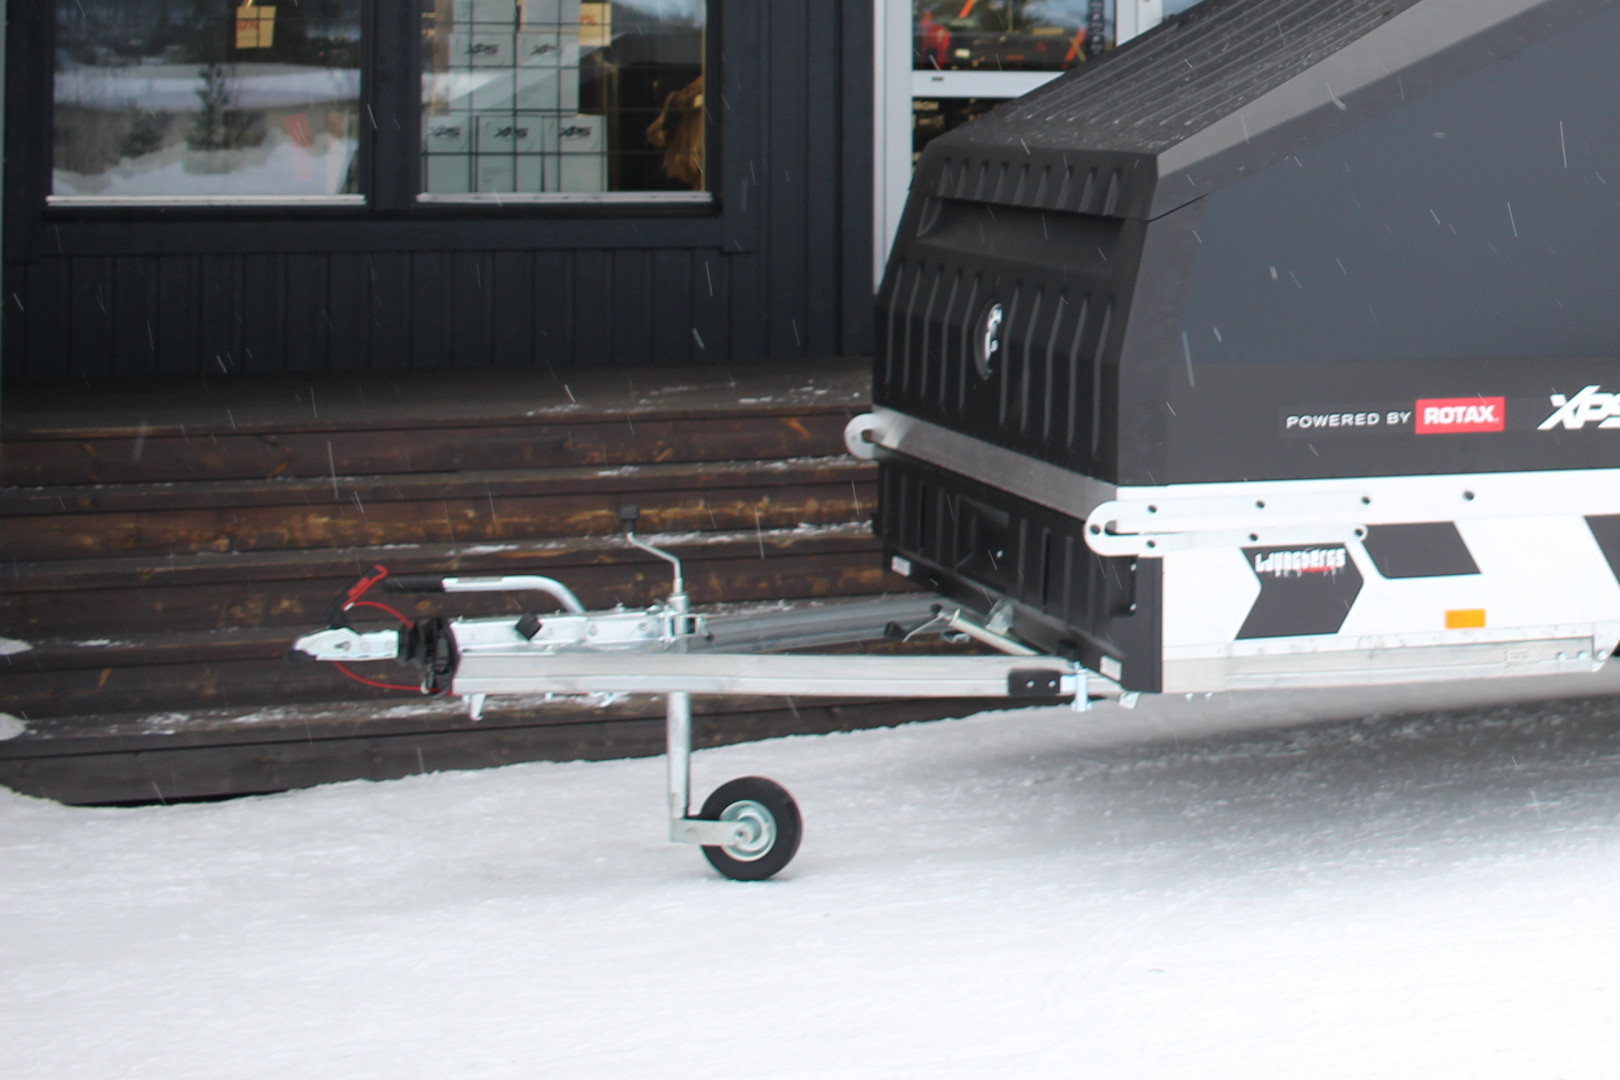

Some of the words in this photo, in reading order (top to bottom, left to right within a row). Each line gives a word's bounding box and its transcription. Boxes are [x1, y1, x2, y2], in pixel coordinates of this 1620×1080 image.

[1286, 412, 1380, 429] POWERED
[1386, 410, 1412, 425] BY
[1423, 404, 1496, 425] ROTAX
